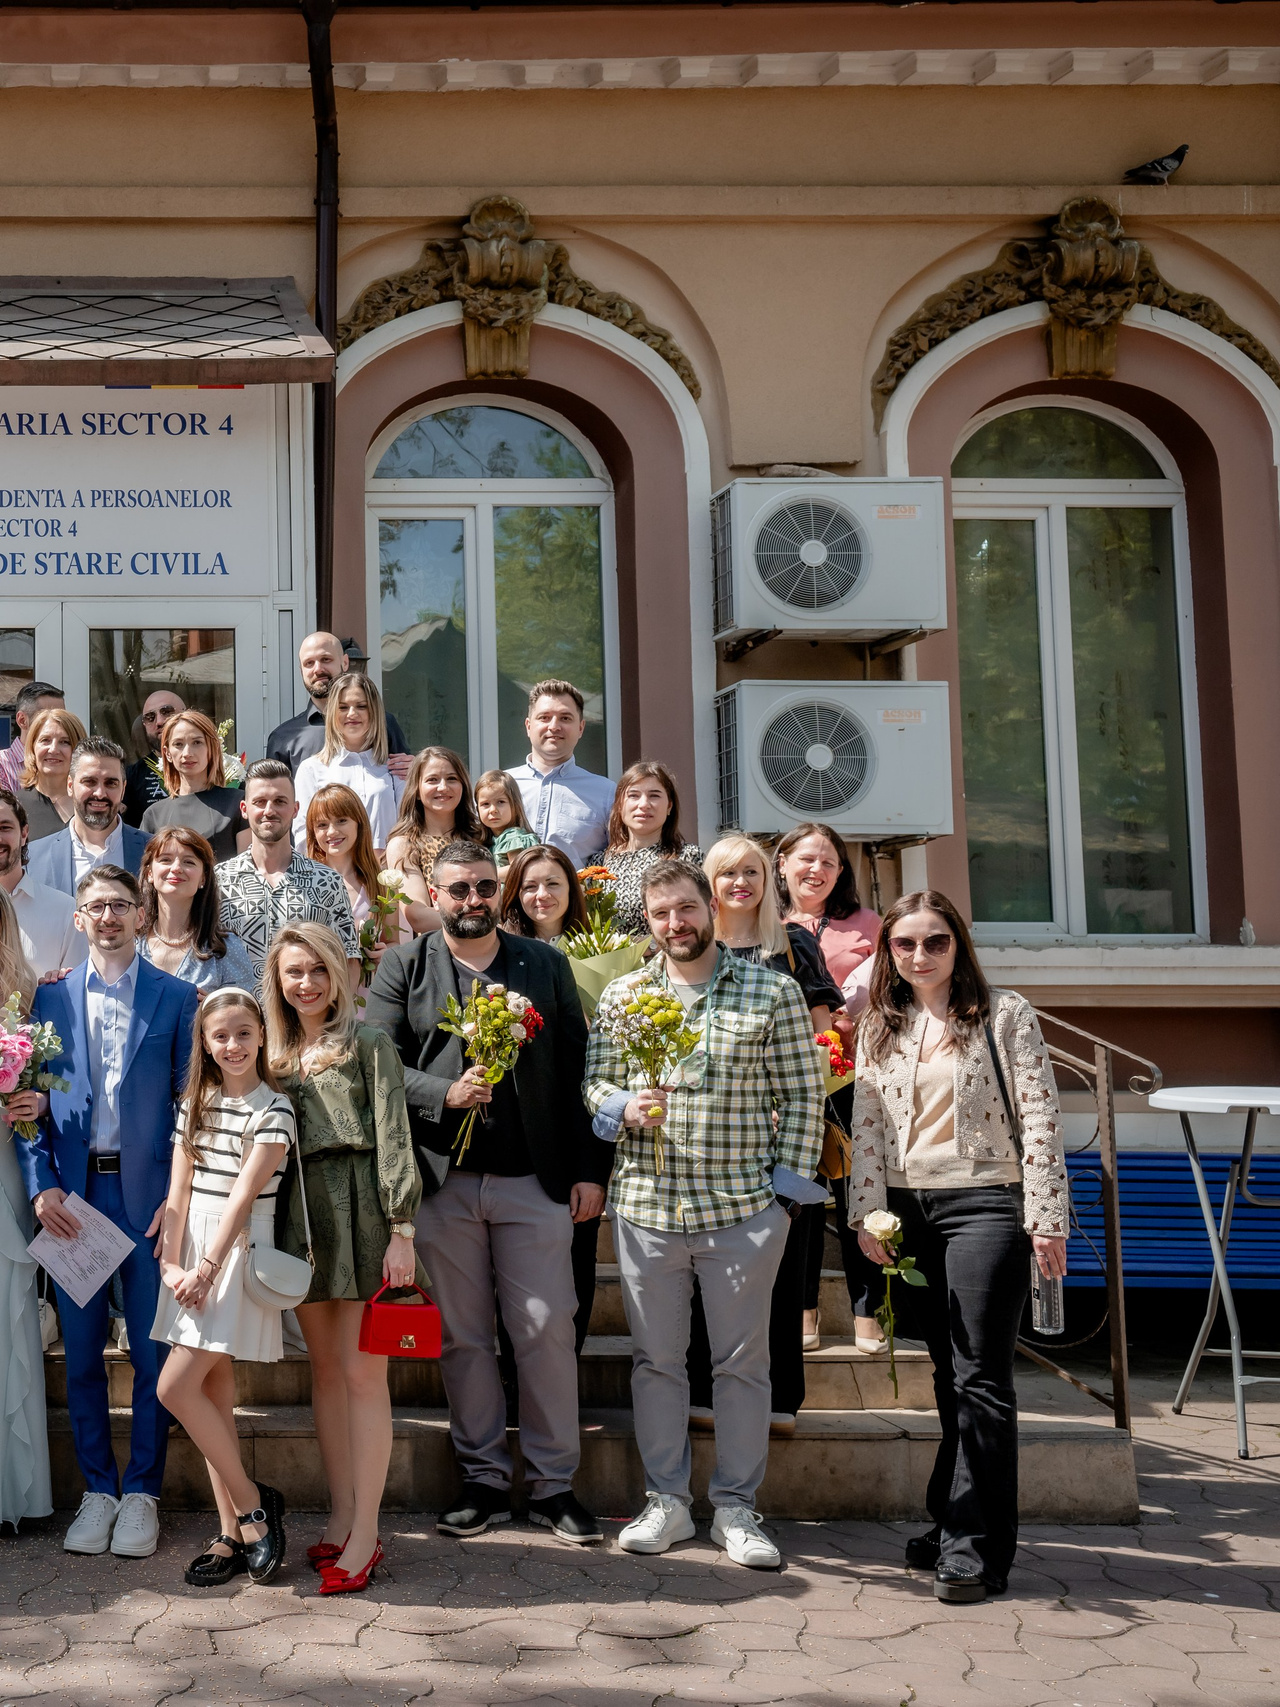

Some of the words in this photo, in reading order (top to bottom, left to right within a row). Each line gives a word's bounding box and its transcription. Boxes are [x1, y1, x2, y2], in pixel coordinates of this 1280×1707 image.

[81, 412, 210, 436] SECTOR
[218, 414, 234, 436] 4
[71, 489, 86, 508] A
[90, 489, 233, 508] PERSOANELOR
[67, 520, 78, 538] 4
[34, 552, 124, 576] STARE
[130, 551, 230, 576] CIVILA
